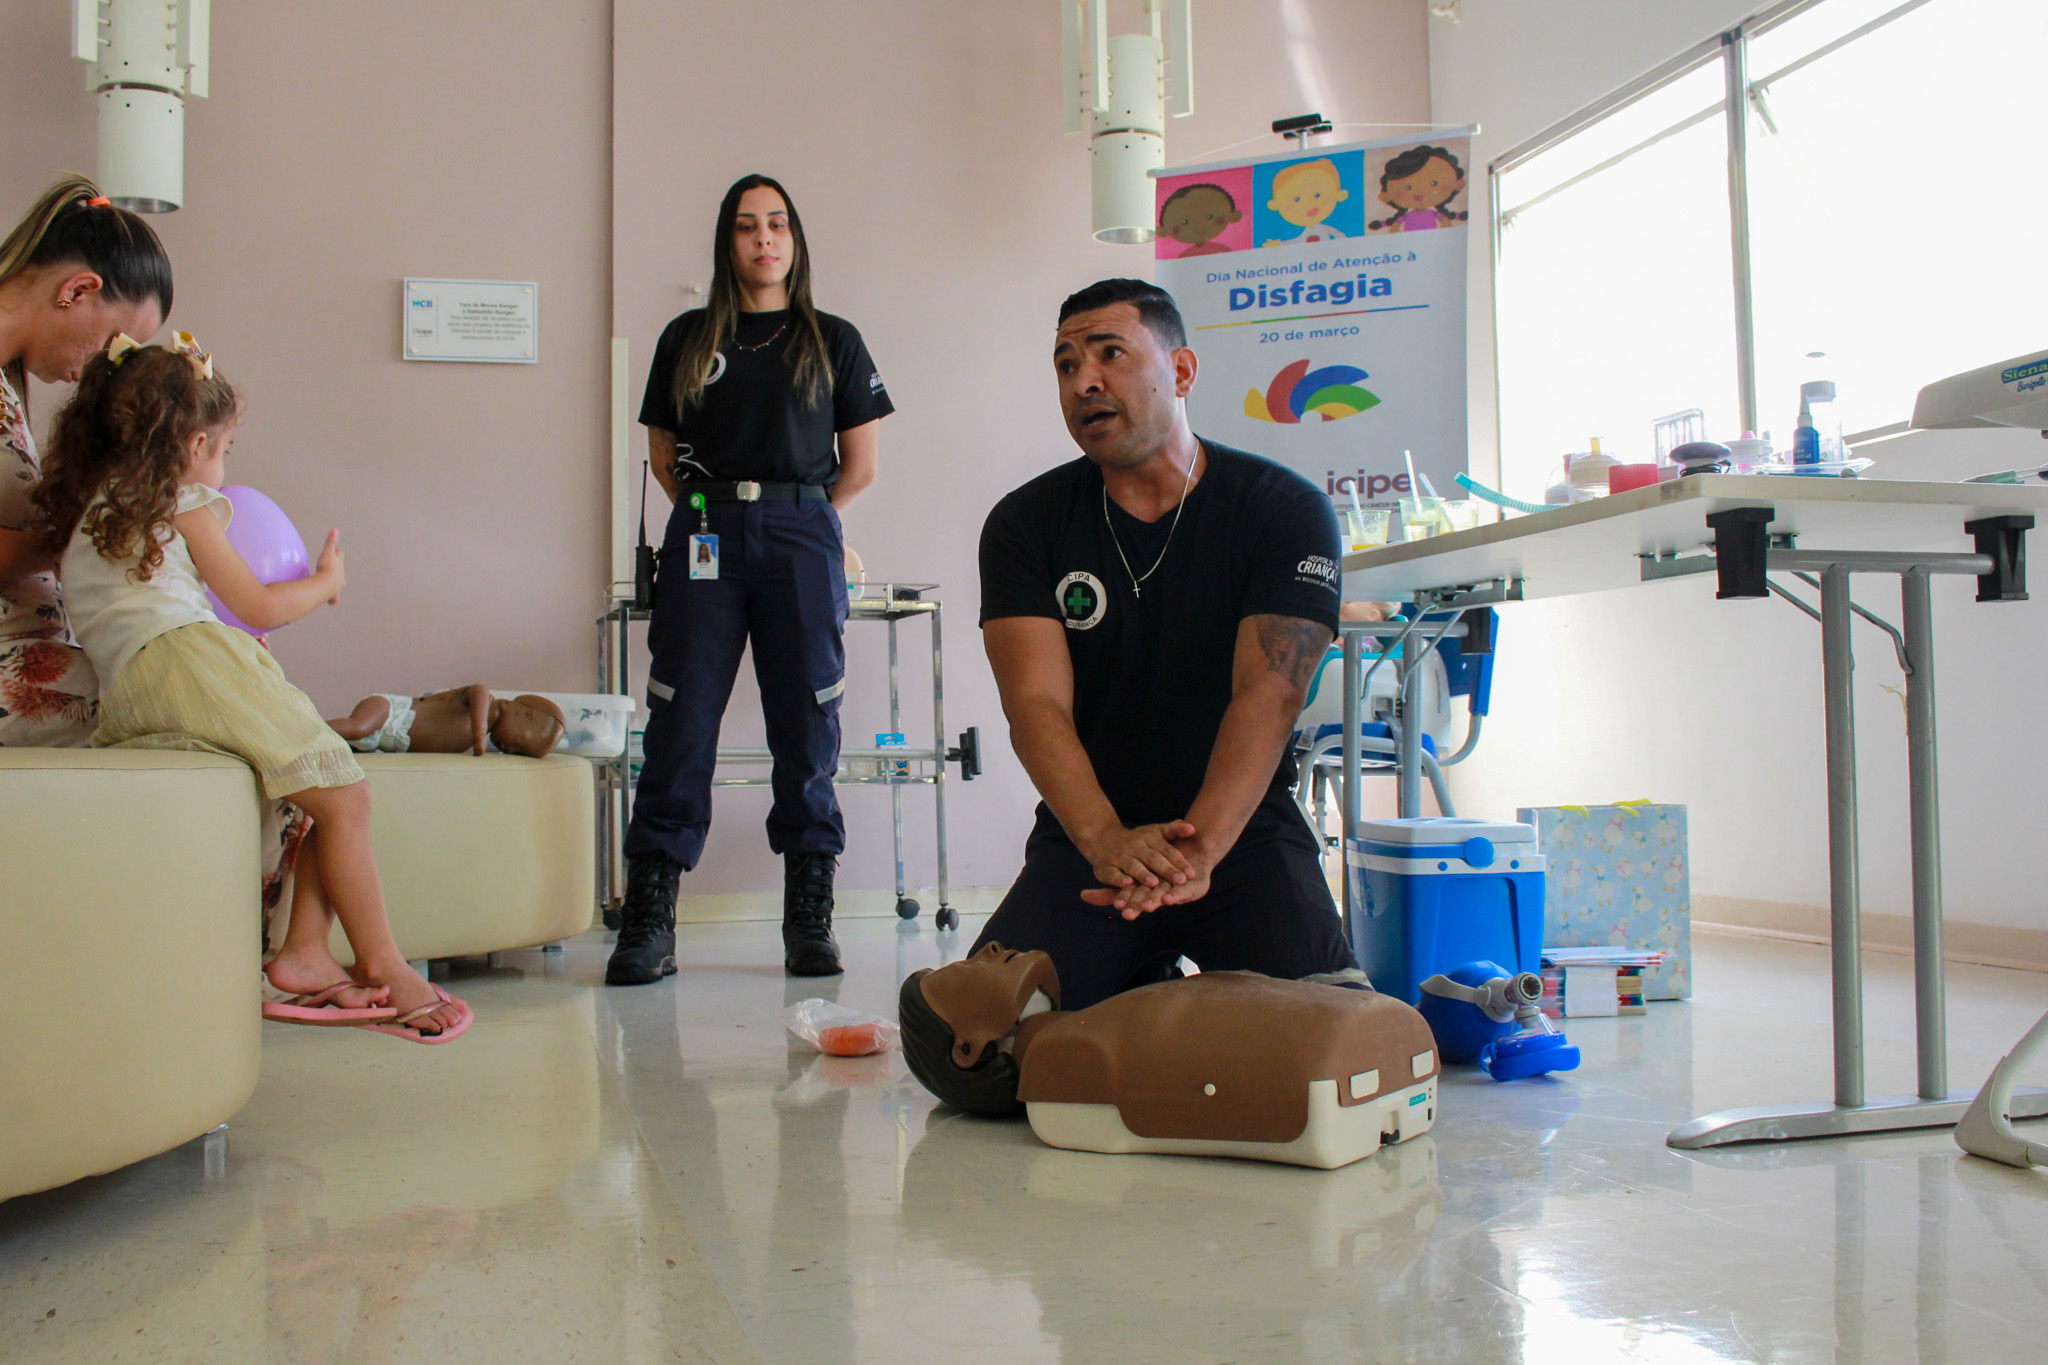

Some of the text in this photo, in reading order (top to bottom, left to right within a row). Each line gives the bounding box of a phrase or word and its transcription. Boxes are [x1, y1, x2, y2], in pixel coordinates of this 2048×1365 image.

[1206, 250, 1417, 283] Dia Nacional de Atenção à
[1229, 273, 1392, 312] Disfagia
[1259, 325, 1360, 344] 20 de março
[2003, 363, 2048, 382] Siena
[1327, 468, 1411, 499] icipe
[1067, 573, 1090, 582] CIPA
[1297, 560, 1335, 582] CRIANÇA
[1066, 616, 1098, 628] GURANÇA
